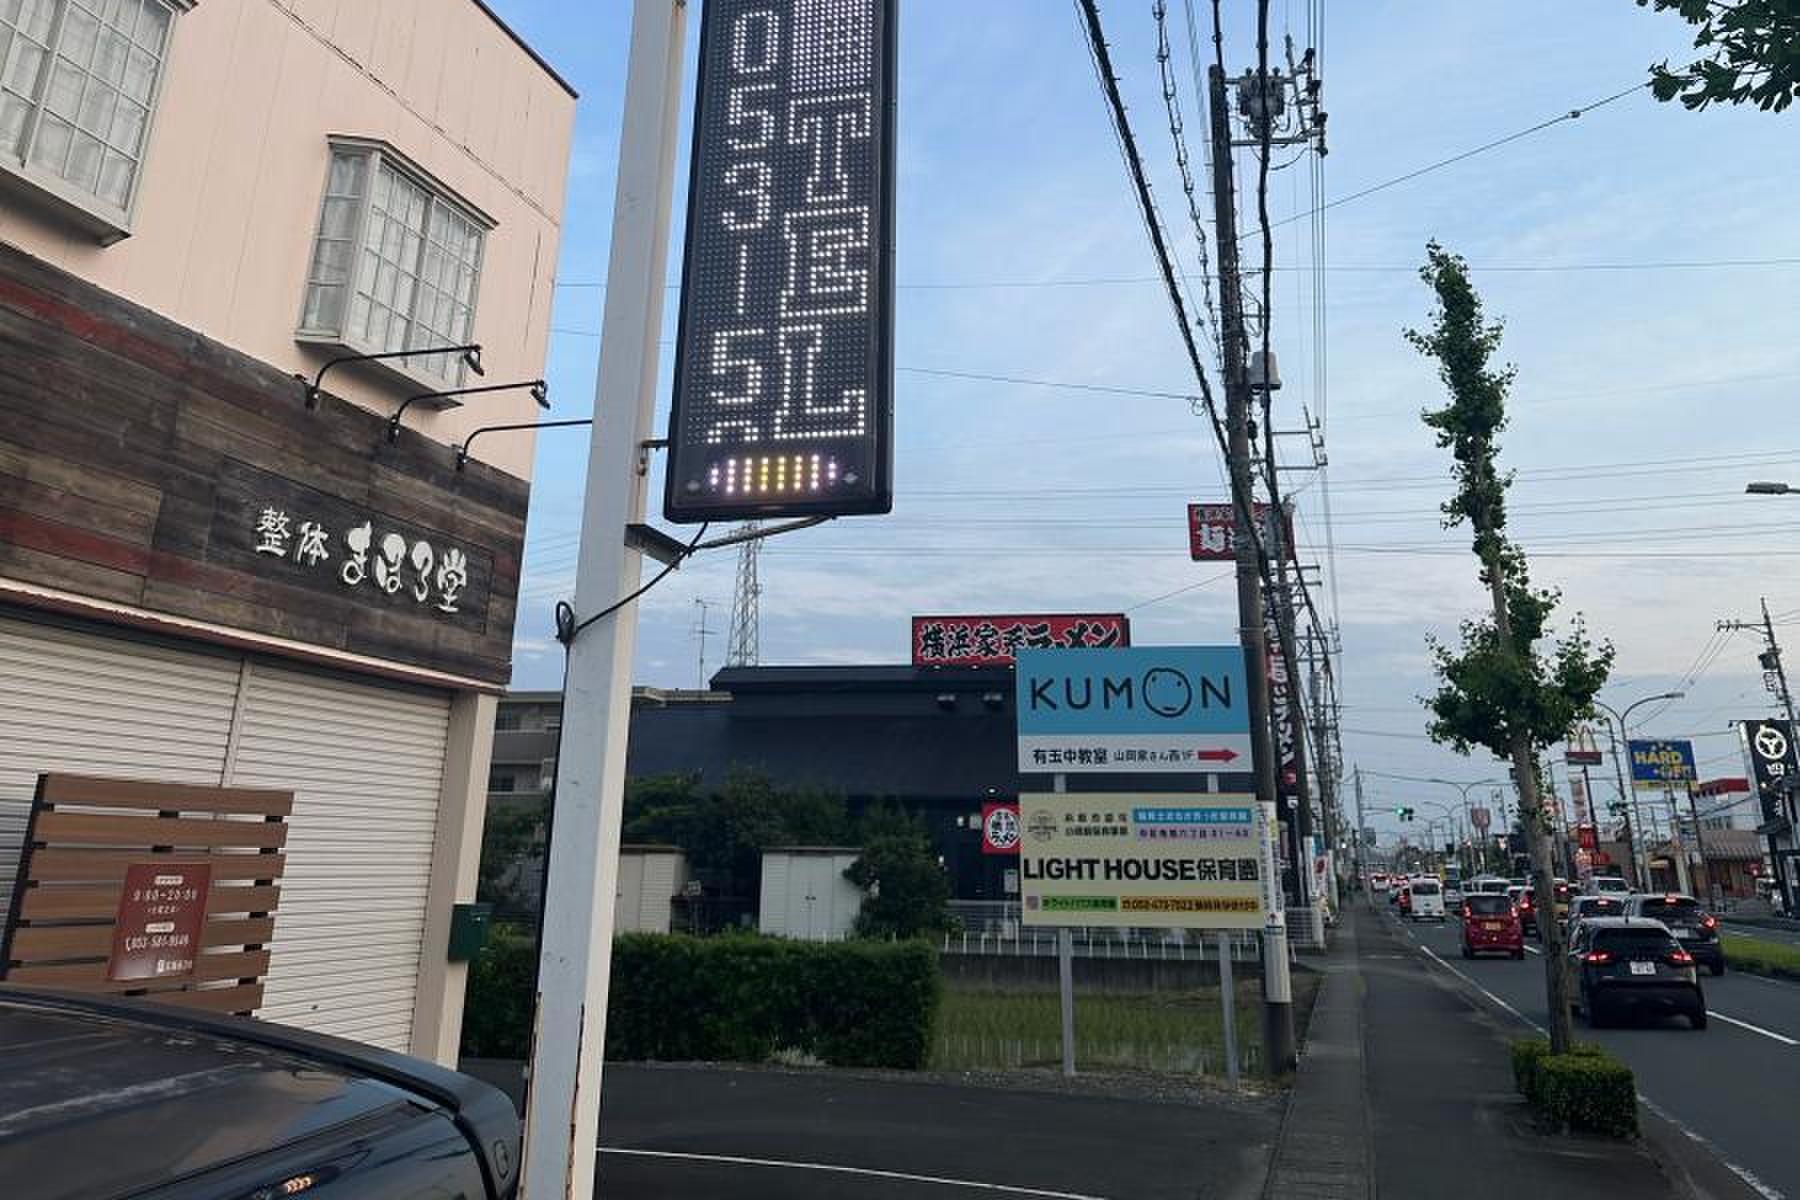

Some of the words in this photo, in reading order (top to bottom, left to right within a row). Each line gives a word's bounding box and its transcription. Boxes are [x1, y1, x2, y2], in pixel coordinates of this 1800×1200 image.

[255, 505, 330, 567] 整体
[342, 520, 468, 613] まほろ堂
[1029, 666, 1232, 718] KUMON
[1032, 748, 1108, 765] 有玉中教室
[1633, 752, 1683, 765] HARD
[1023, 858, 1100, 880] LIGHT
